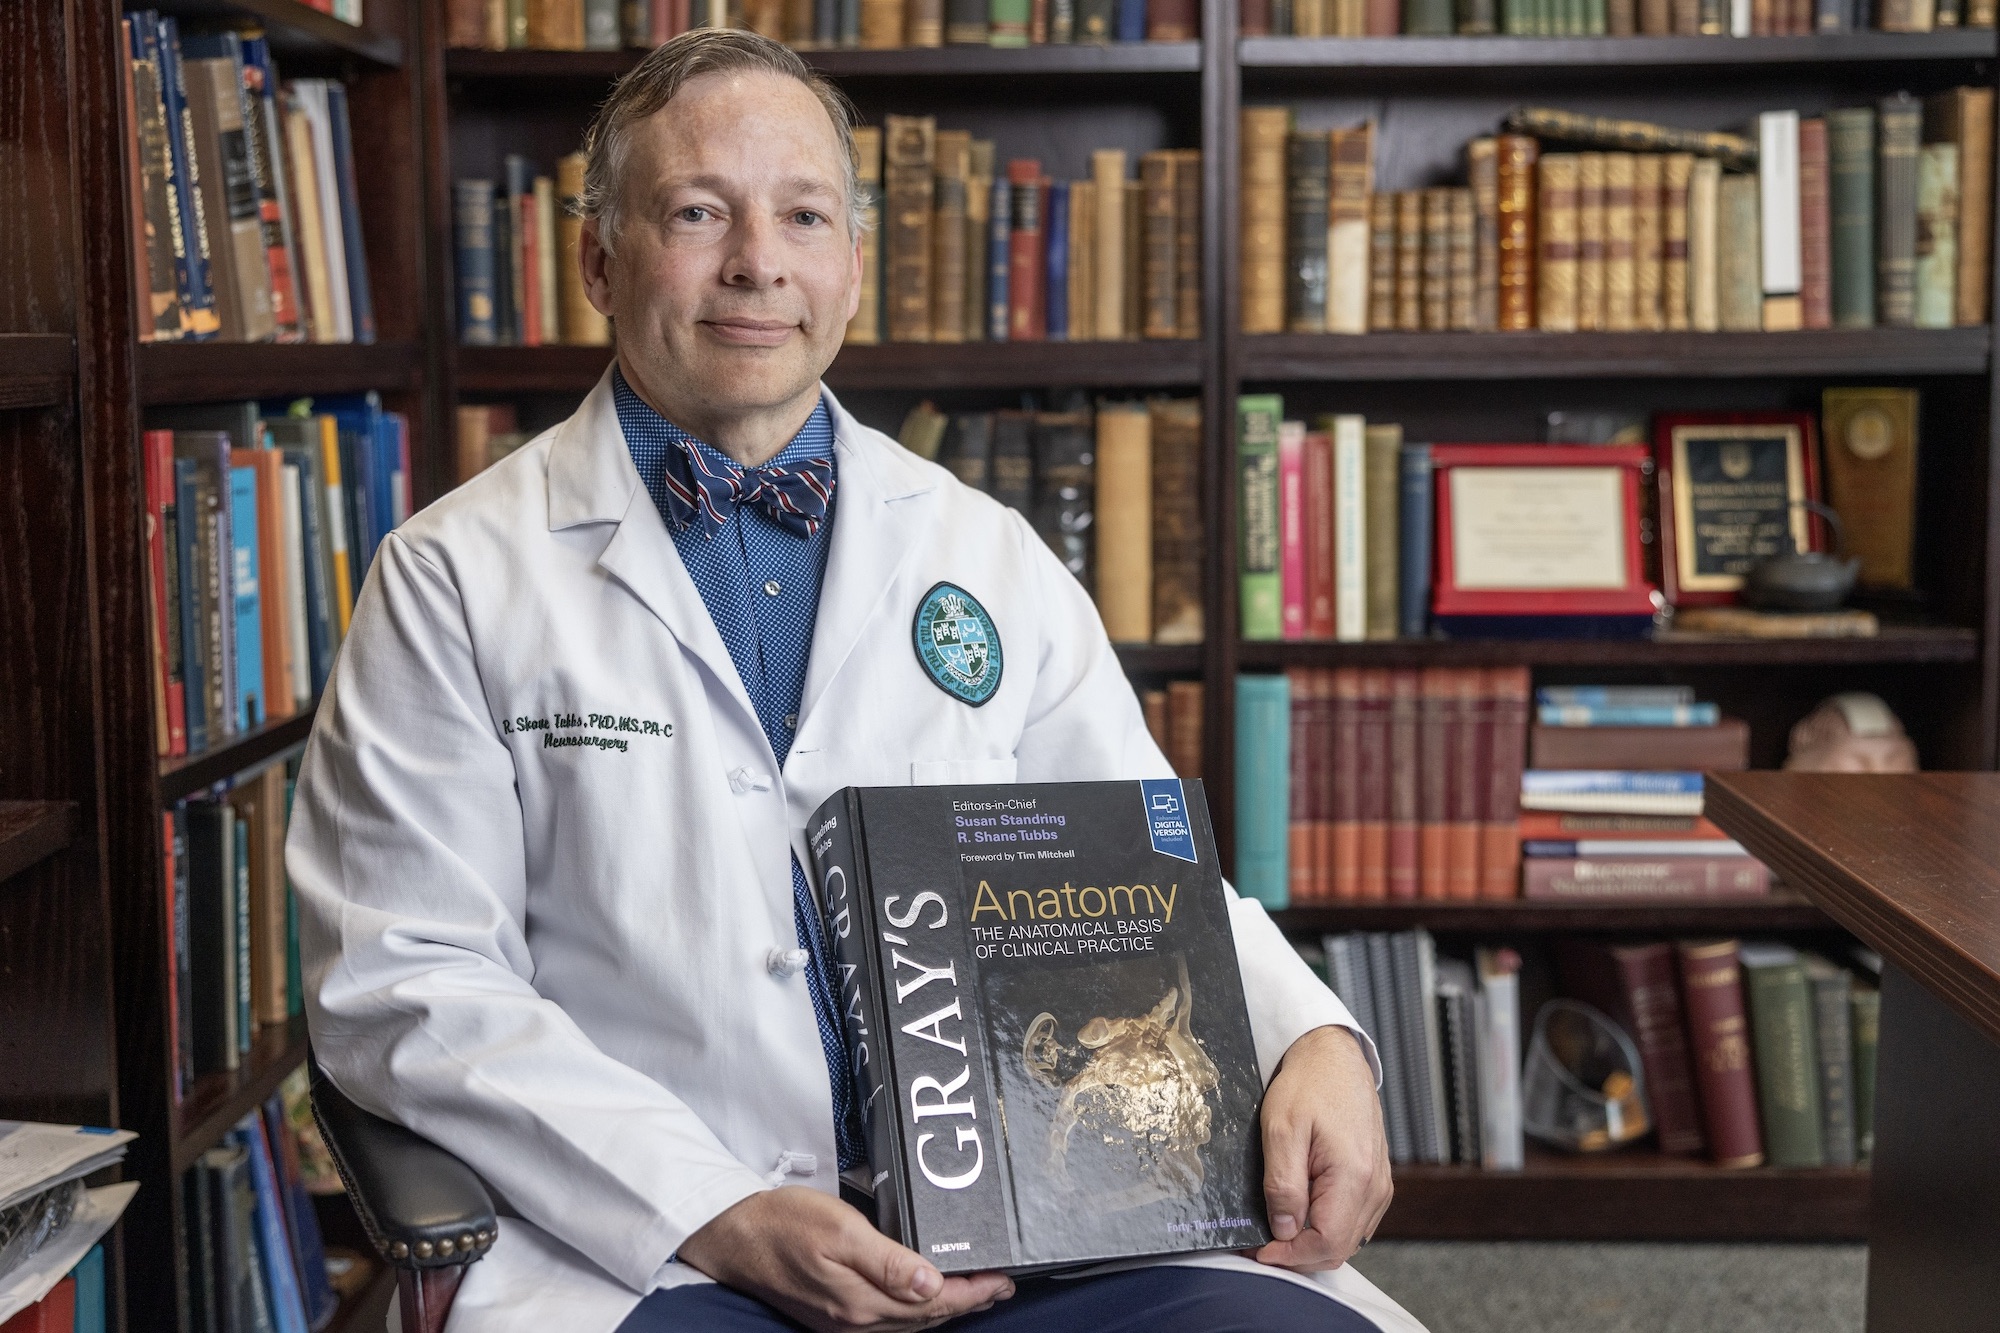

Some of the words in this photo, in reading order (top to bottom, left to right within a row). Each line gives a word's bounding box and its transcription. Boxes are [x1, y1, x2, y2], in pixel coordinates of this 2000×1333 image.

[516, 715, 550, 732] Shane
[544, 733, 628, 752] Neurosurgery
[952, 799, 1037, 812] Editors-in-Chief
[955, 815, 997, 828] Susan
[1000, 813, 1066, 828] Standring
[1154, 821, 1185, 829] DIGITAL
[957, 831, 971, 843] R.
[974, 830, 1017, 843] Shane
[1017, 829, 1058, 841] Tubbs
[1153, 828, 1188, 836] VERSION
[960, 852, 1002, 863] Foreword
[1004, 851, 1015, 862] by
[1017, 850, 1036, 860] Tim
[1037, 849, 1075, 860] Mitchell
[970, 880, 1178, 924] Anatomy
[972, 926, 1004, 941] THE
[1008, 921, 1114, 940] ANATOMICAL
[1117, 918, 1163, 934] BASIS
[975, 943, 999, 959] OF
[1001, 940, 1075, 958] CLINICAL
[1077, 936, 1155, 954] PRACTICE
[883, 891, 984, 1190] GRAY'S
[1166, 1219, 1218, 1233] Forty-Third
[1219, 1217, 1252, 1229] Edition
[931, 1242, 971, 1253] ELSEVIER
